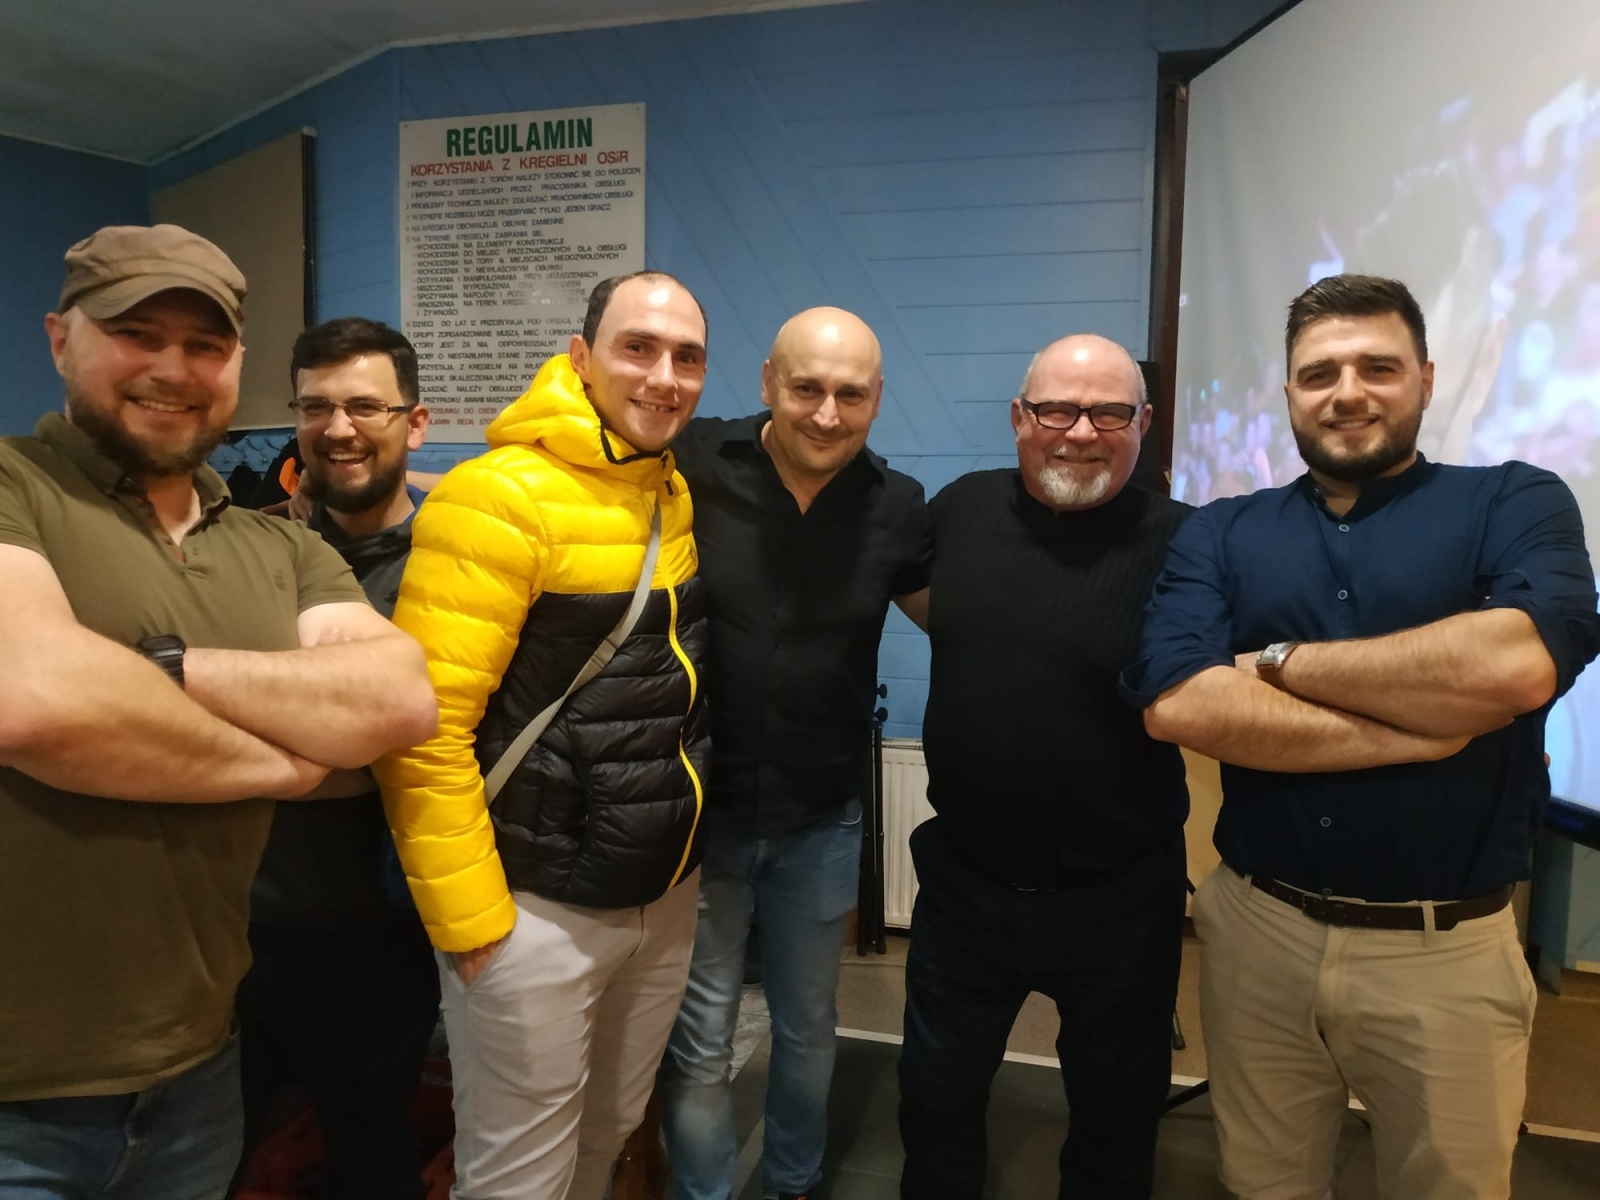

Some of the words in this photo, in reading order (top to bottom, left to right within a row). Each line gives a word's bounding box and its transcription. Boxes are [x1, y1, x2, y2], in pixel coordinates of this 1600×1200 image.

[446, 117, 593, 157] REGULAMIN
[410, 159, 493, 176] KORZYSTANIA
[502, 158, 510, 171] Z
[519, 152, 586, 170] KRĘGIELNI
[433, 176, 477, 186] KORZYSTANIU
[490, 174, 513, 182] TORÓW
[595, 168, 605, 176] DO
[415, 190, 452, 198] INFORMACJI
[458, 186, 503, 195] UDZIELANYCH
[541, 181, 586, 190] PRACOWNIKA
[411, 201, 443, 209] PROBLEMY
[447, 199, 480, 207] TECHNICZE
[551, 192, 602, 201] PRACOWNIKOWI
[539, 206, 560, 214] TYLKO
[588, 203, 611, 211] GRACZ
[531, 218, 564, 226] ZAMIENNE
[516, 238, 563, 246] KONSTRUKCJI
[507, 246, 570, 254] PRZEZNACZONYCH
[510, 255, 547, 263] MIEJSCACH
[554, 252, 619, 261] NIEDOZWOLONYCH
[463, 274, 516, 282] MANIPULOWANIA
